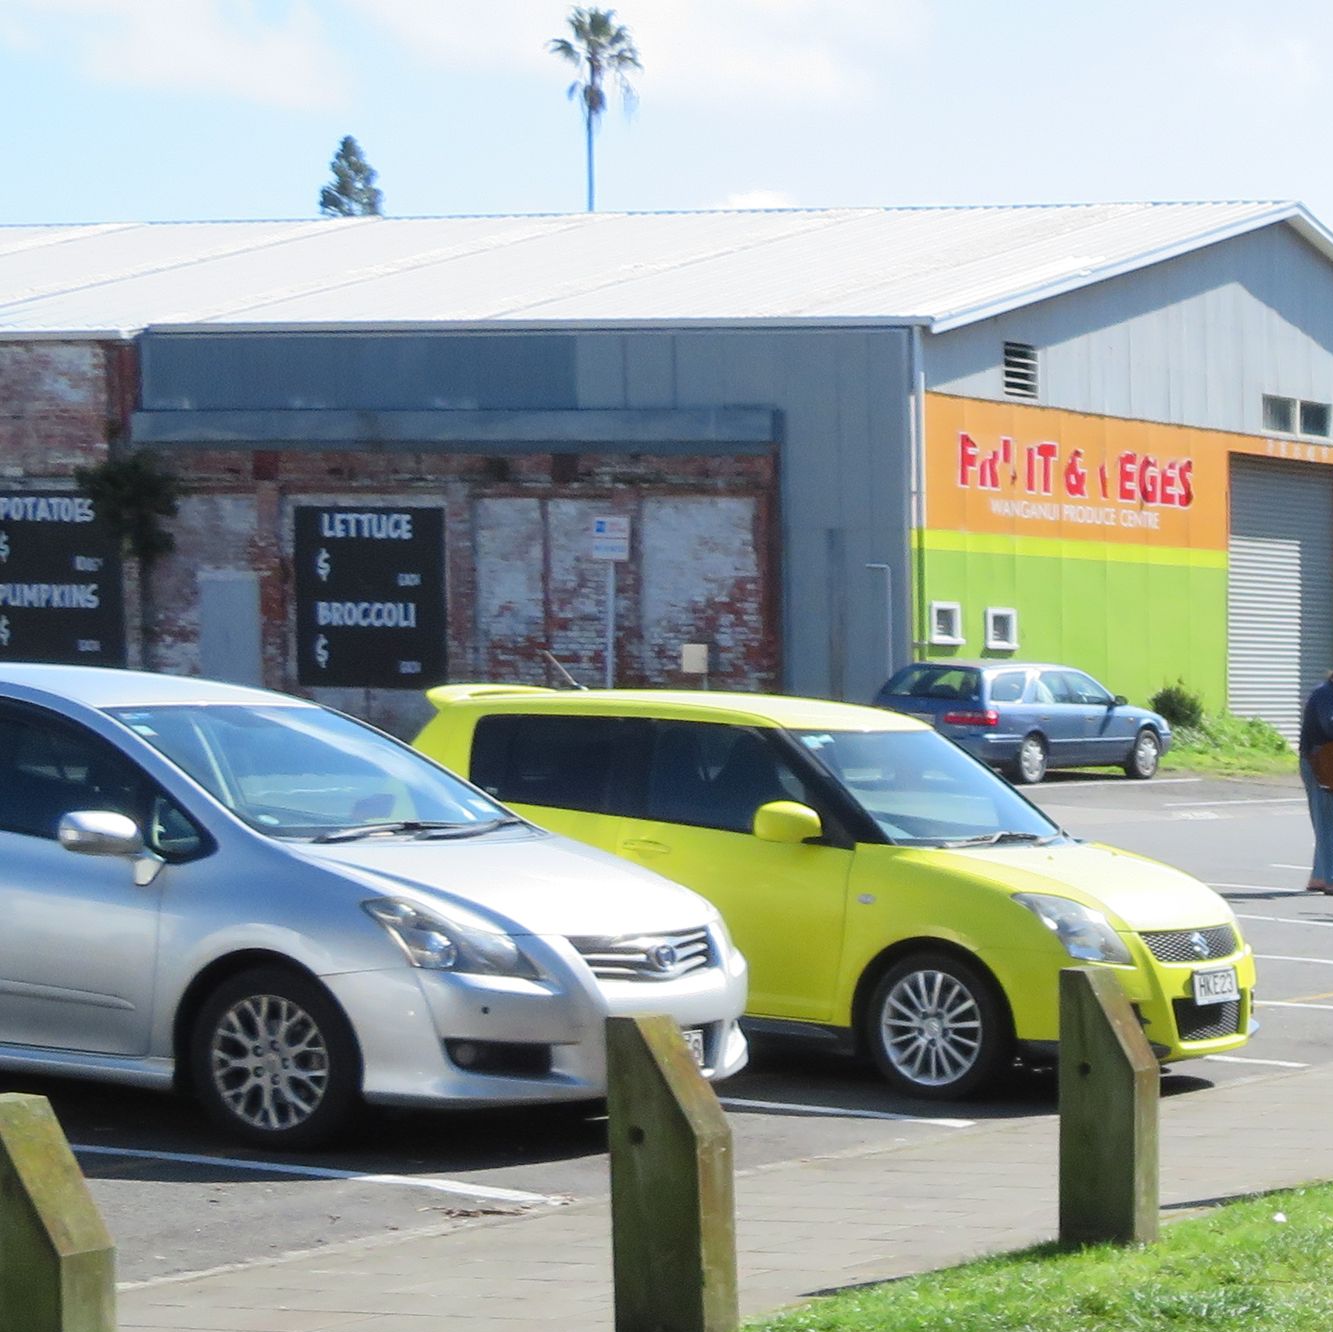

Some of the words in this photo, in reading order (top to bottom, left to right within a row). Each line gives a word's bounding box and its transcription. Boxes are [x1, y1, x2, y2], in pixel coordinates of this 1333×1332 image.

[957, 431, 1059, 496] FRIT
[1064, 448, 1088, 499] &
[1097, 450, 1194, 509] EGES
[0, 497, 95, 522] POTATOES
[990, 498, 1060, 521] WANGANUI
[1062, 503, 1116, 526] PRODUCE
[1119, 508, 1160, 530] CENTRE
[321, 512, 413, 540] LETTUCE
[317, 547, 331, 582] $
[0, 583, 99, 609] PUMPKINS
[317, 601, 416, 628] BROCCOLI
[316, 633, 329, 669] $
